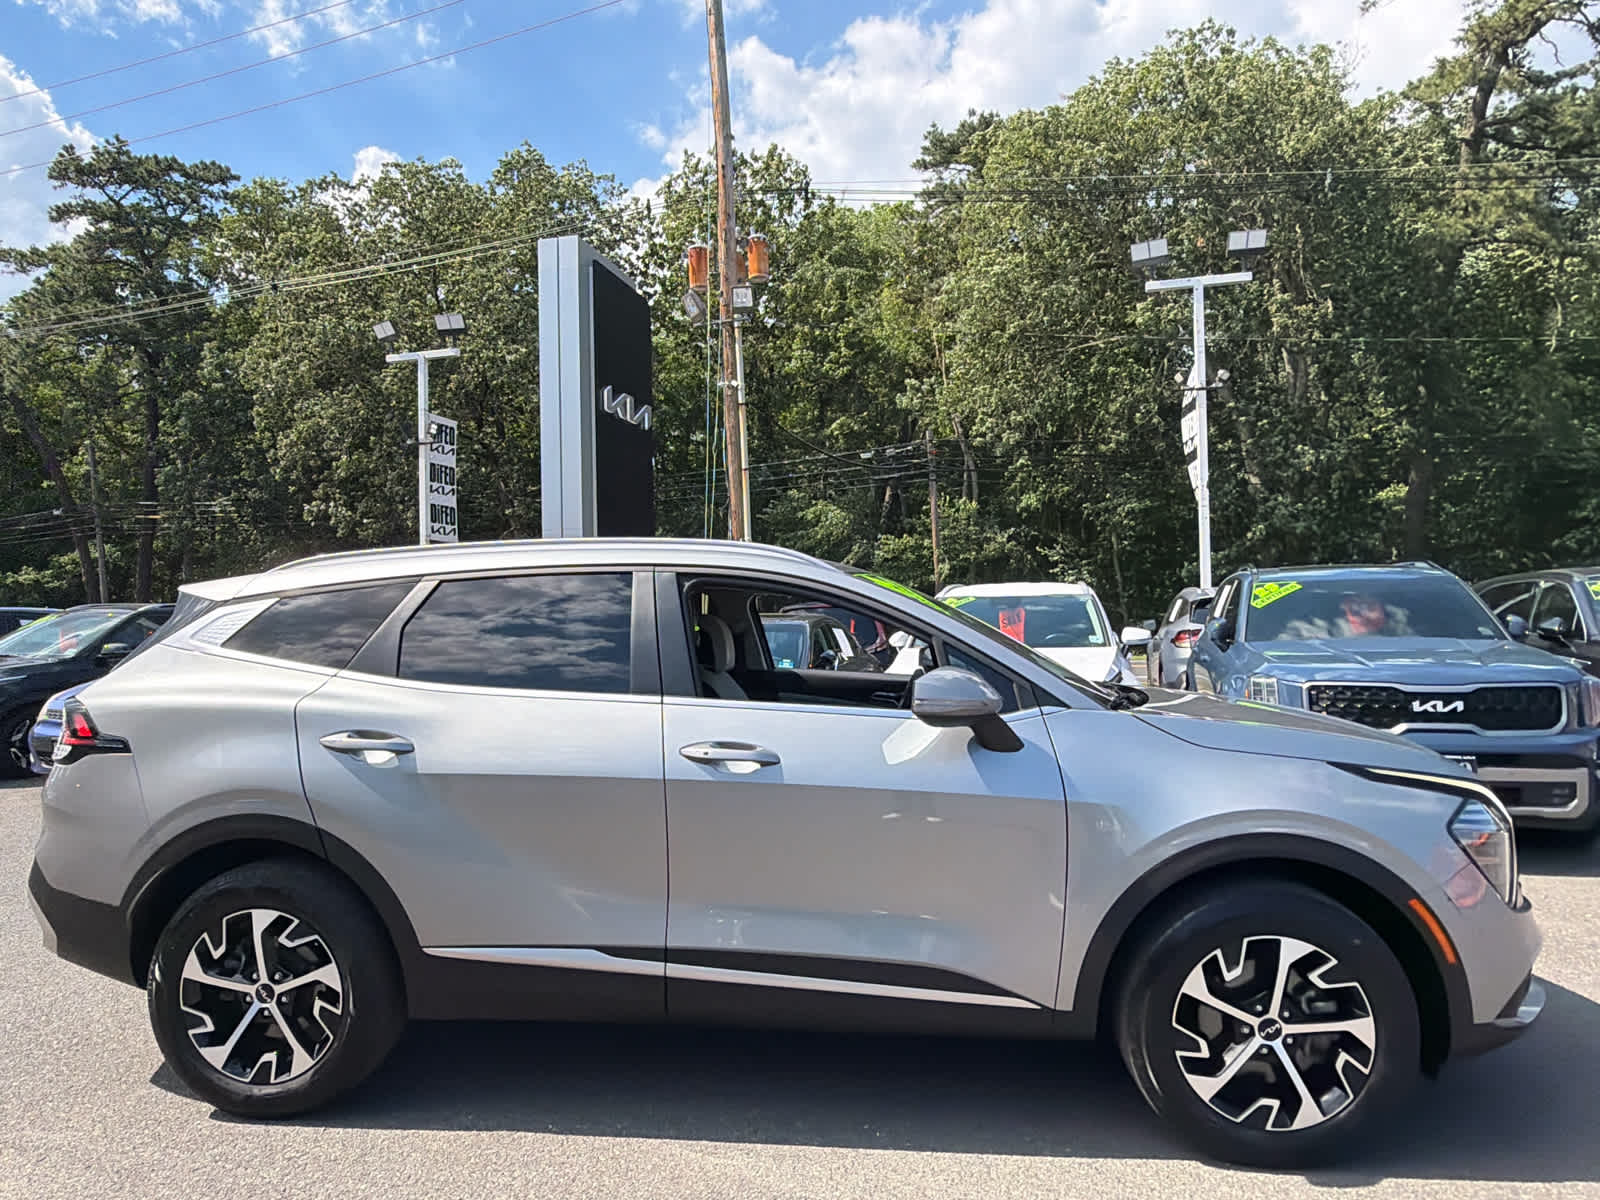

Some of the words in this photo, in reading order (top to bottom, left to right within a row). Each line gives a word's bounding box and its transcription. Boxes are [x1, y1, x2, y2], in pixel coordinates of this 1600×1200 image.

[602, 385, 652, 431] KIA
[430, 485, 455, 496] KIA
[431, 525, 456, 537] KIA
[1411, 699, 1465, 713] KIA
[1260, 1023, 1281, 1038] KIA
